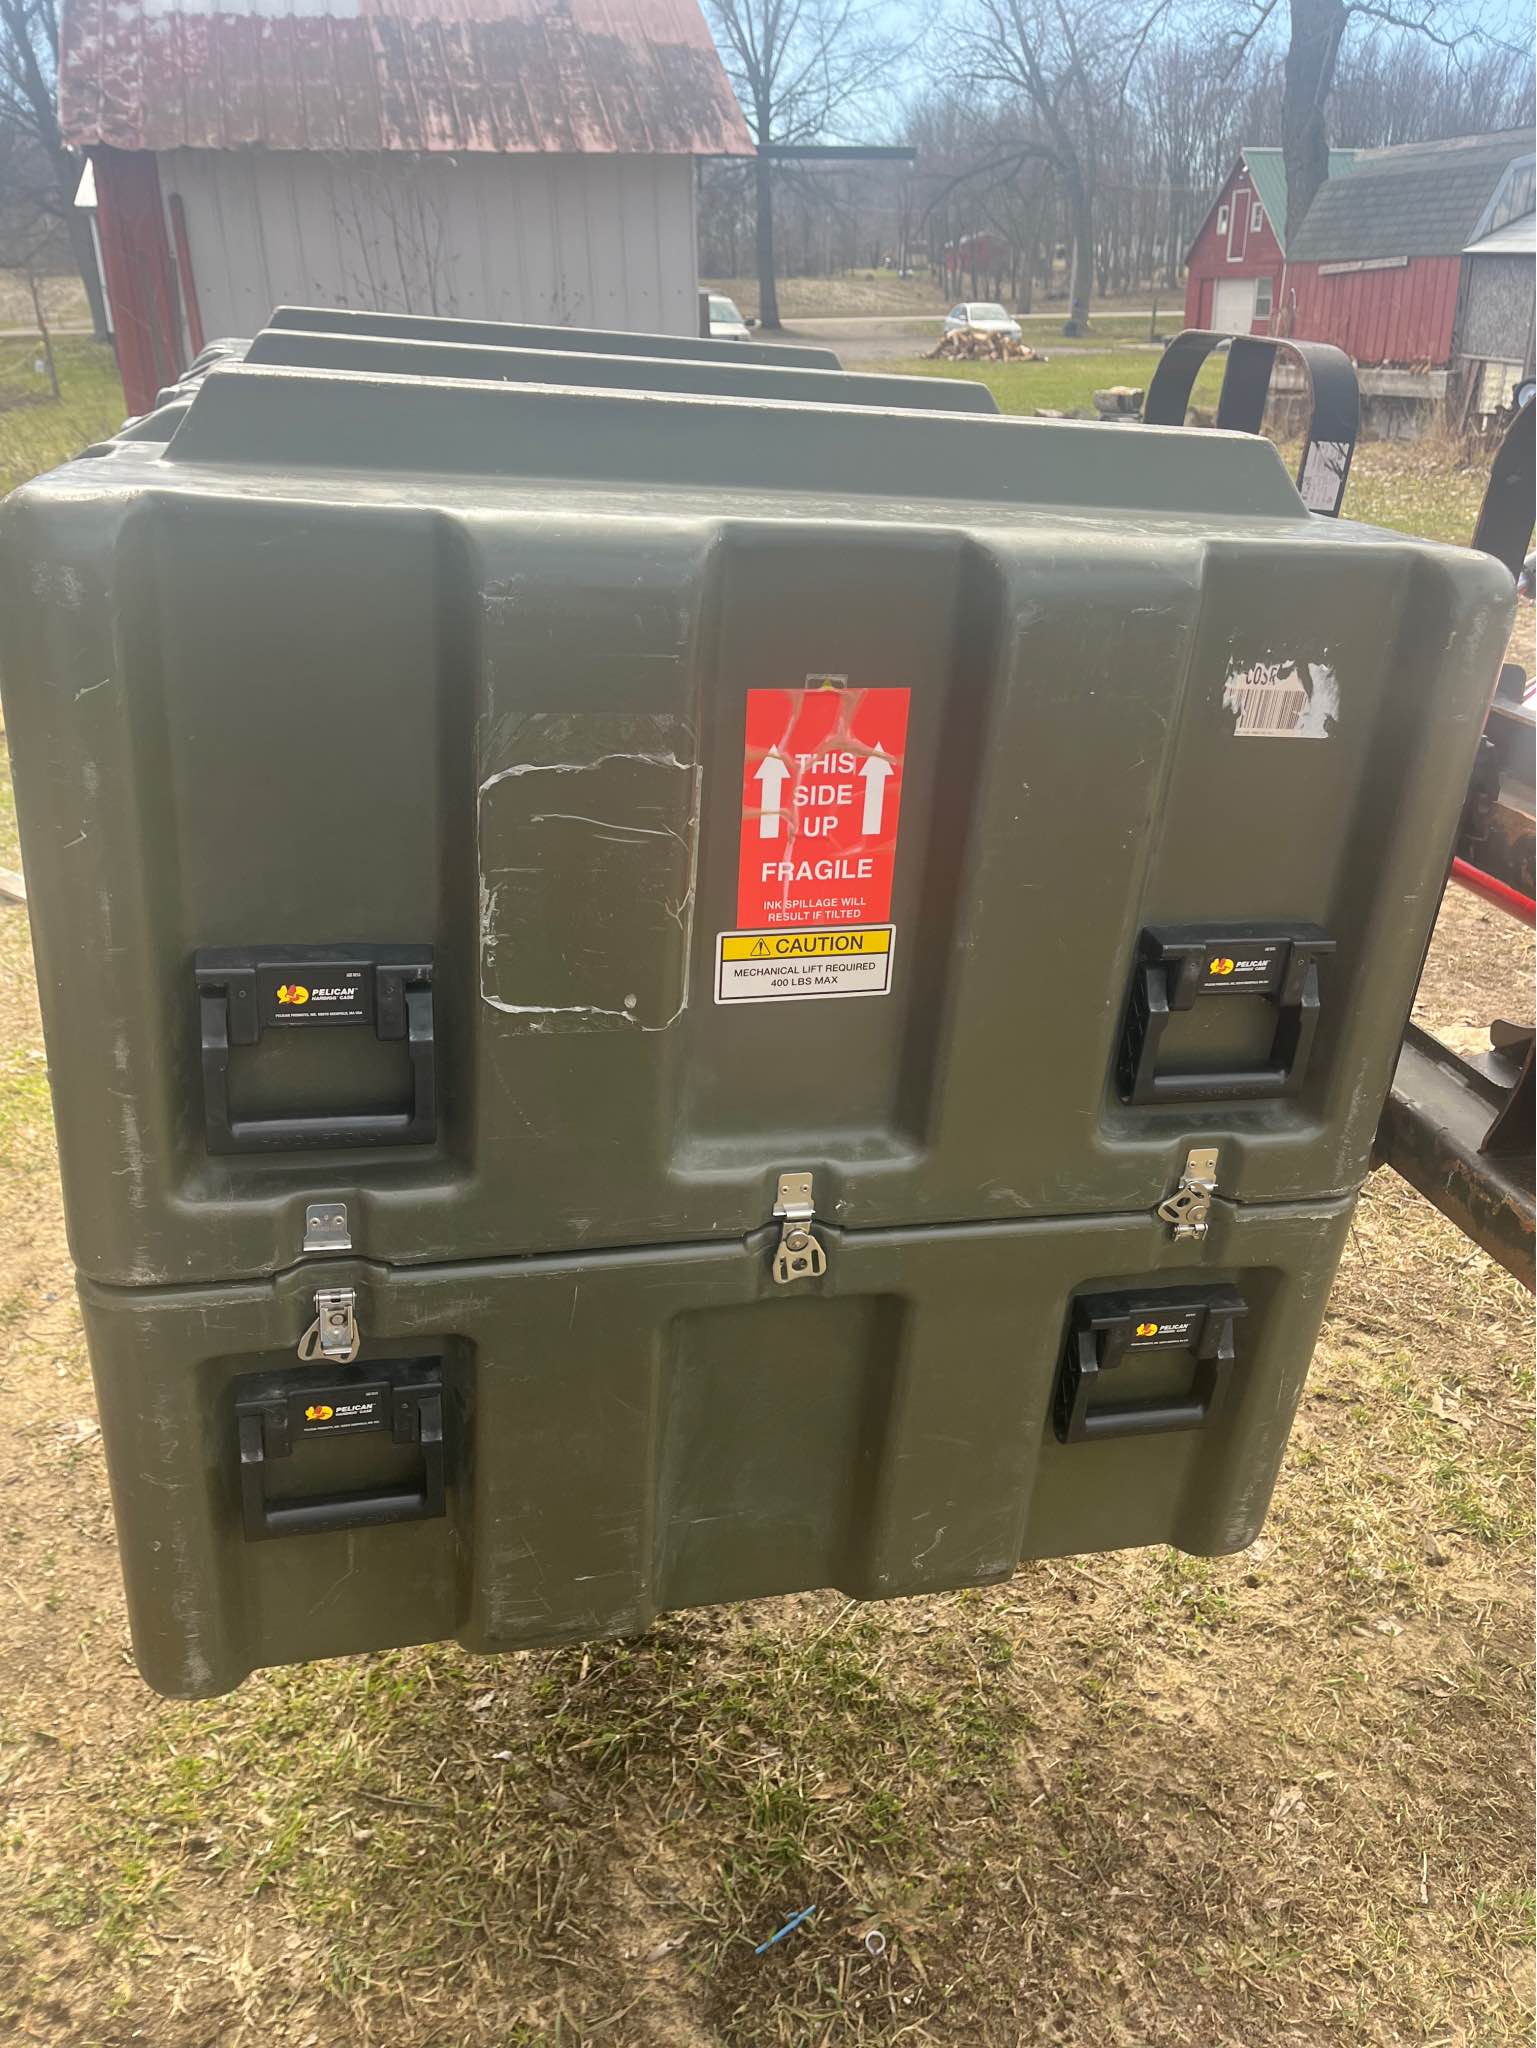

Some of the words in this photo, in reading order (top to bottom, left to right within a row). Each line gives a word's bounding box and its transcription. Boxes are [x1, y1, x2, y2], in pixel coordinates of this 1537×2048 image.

[795, 752, 856, 775] THIS
[793, 784, 853, 806] SIDE
[803, 816, 839, 838] UP
[761, 858, 873, 883] FRAGILE
[763, 901, 782, 910] INK
[784, 898, 838, 909] SPILLAGE
[841, 897, 866, 907] WILL
[768, 911, 810, 922] RESULT
[813, 910, 823, 920] IF
[825, 909, 861, 919] TILTED
[775, 935, 864, 954] CAUTION
[734, 965, 800, 978] MECHANICAL
[802, 964, 823, 975] LIFT
[825, 962, 876, 973] REQUIRED
[1236, 960, 1268, 968] PELICAN
[770, 978, 789, 988] 400
[791, 977, 812, 987] LBS
[814, 976, 839, 986] MAX
[312, 987, 355, 996] PELICAN
[1159, 1323, 1189, 1331] PELICAN
[336, 1403, 373, 1413] PELICAN
